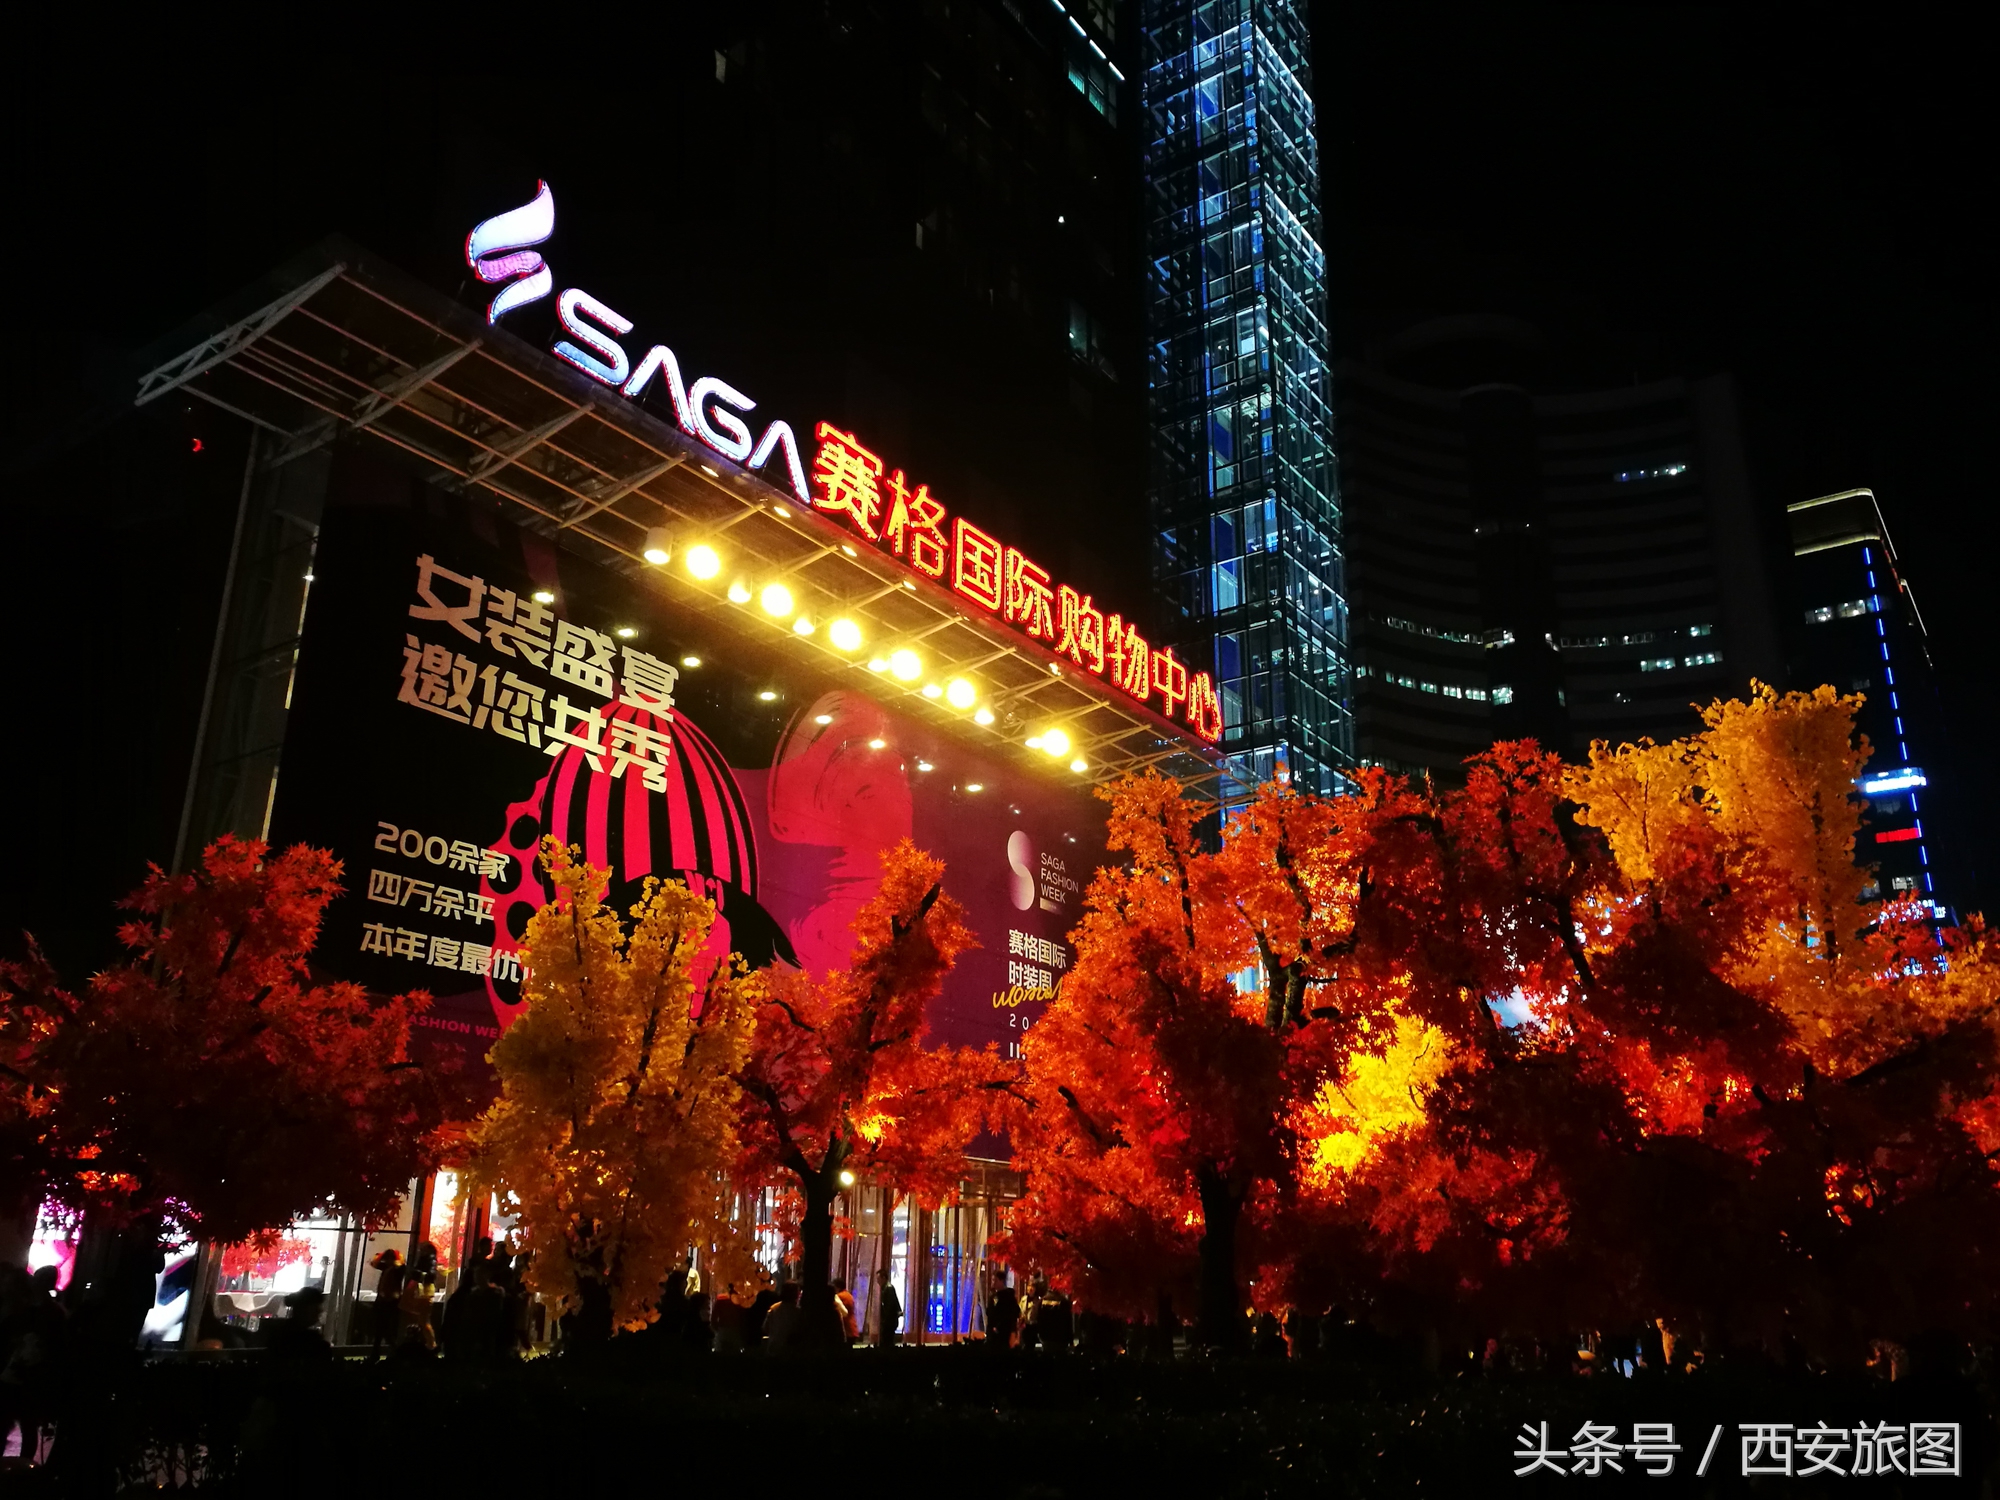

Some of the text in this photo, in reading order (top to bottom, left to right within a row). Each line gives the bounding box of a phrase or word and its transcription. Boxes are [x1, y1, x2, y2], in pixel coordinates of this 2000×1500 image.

[551, 288, 1223, 743] SAGA 赛格国际购物中心
[408, 553, 679, 722] 女装盛宴
[397, 633, 672, 793] 邀您共秀
[375, 821, 510, 882] 200余家
[1041, 852, 1065, 872] SAGA
[367, 869, 496, 925] 四万余平
[1041, 868, 1079, 893] FASHION
[1041, 884, 1066, 904] WEEK
[360, 923, 536, 983] 本年度最优
[1009, 929, 1066, 969] 赛格国际
[1009, 960, 1052, 991] 时装周
[406, 1014, 471, 1034] ASHION
